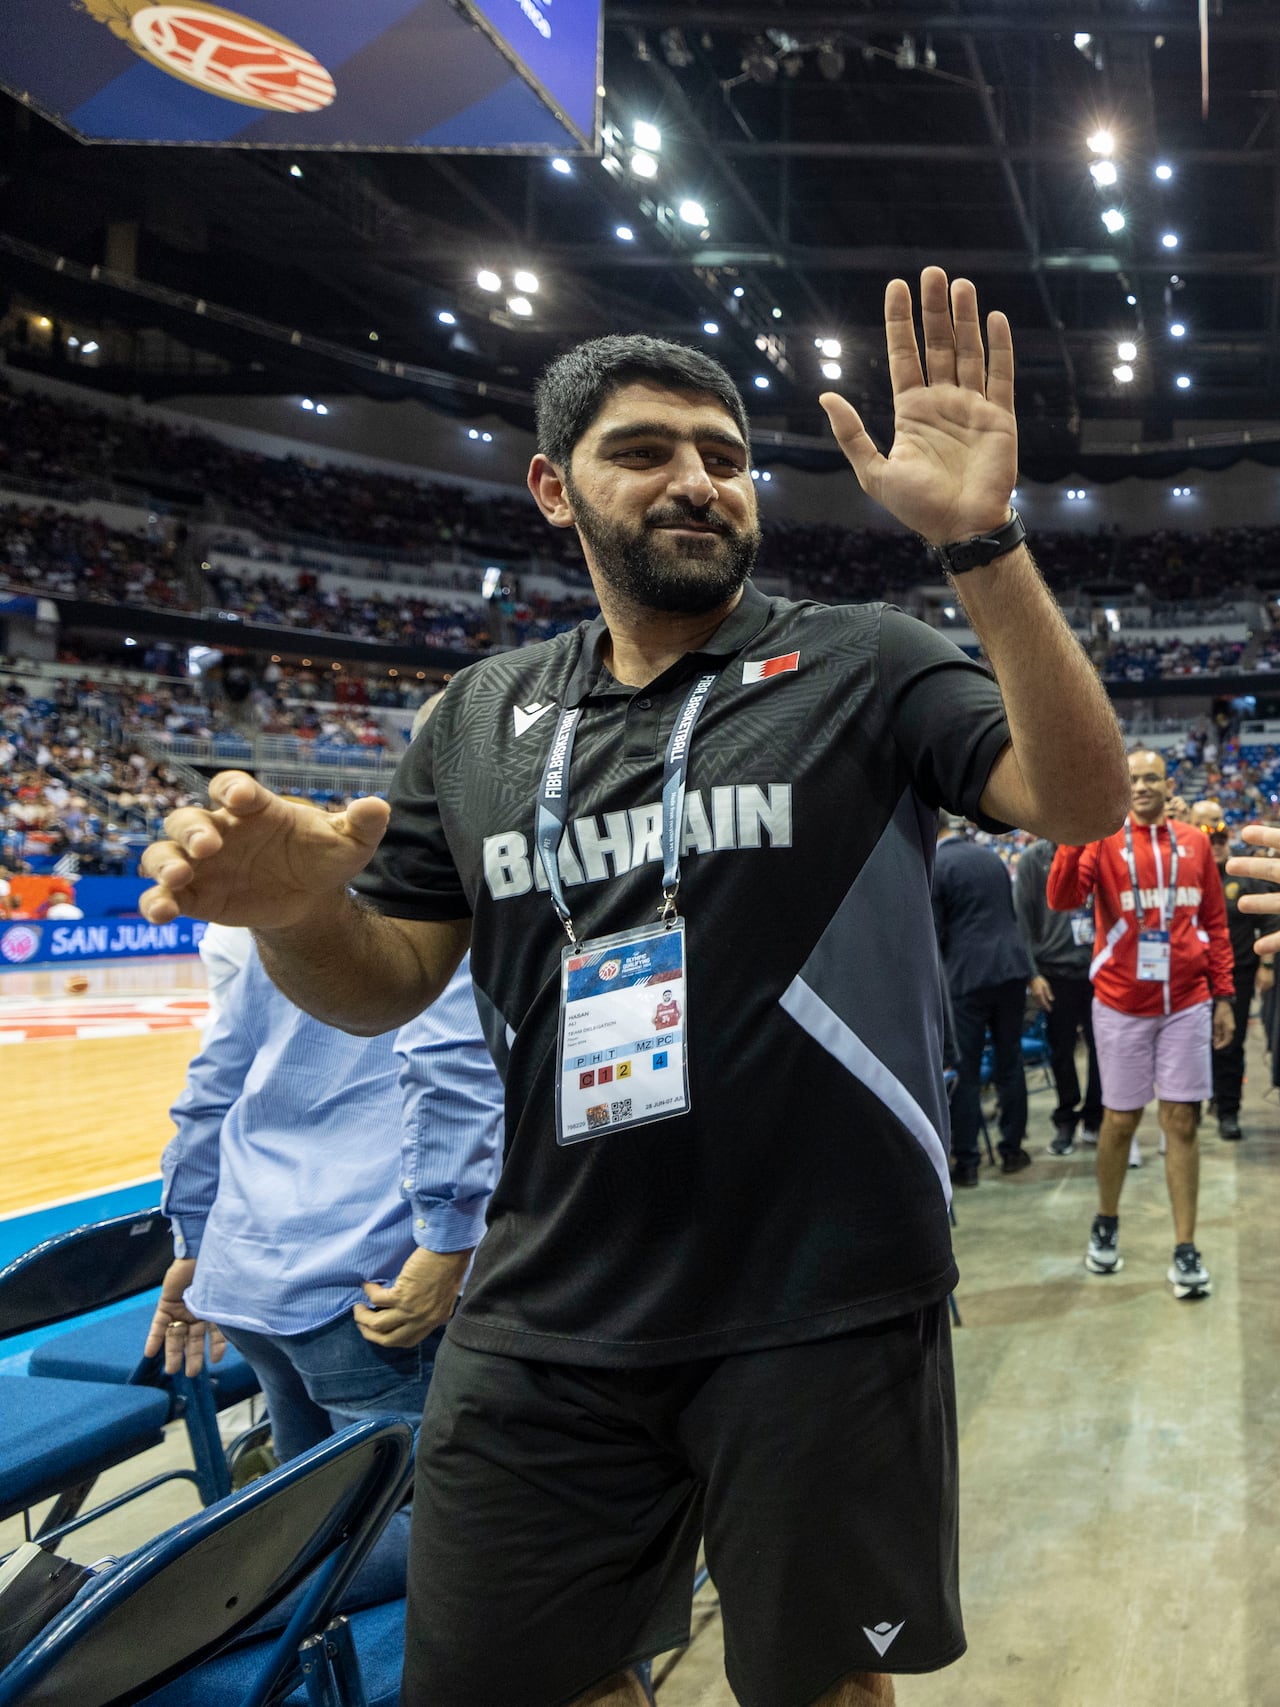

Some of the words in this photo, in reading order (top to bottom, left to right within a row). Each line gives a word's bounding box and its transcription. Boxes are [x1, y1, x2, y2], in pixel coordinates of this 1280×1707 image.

[670, 674, 716, 764] FIBA.BASKETBALL
[483, 783, 793, 900] BAHRAIN
[51, 925, 109, 955] SAN
[110, 923, 179, 951] JUAN
[577, 1058, 585, 1067] P
[593, 1054, 600, 1063] H
[609, 1050, 616, 1058] T
[657, 1035, 673, 1046] PC
[582, 1074, 593, 1086] C
[620, 1064, 628, 1076] 2
[656, 1055, 664, 1065] 4
